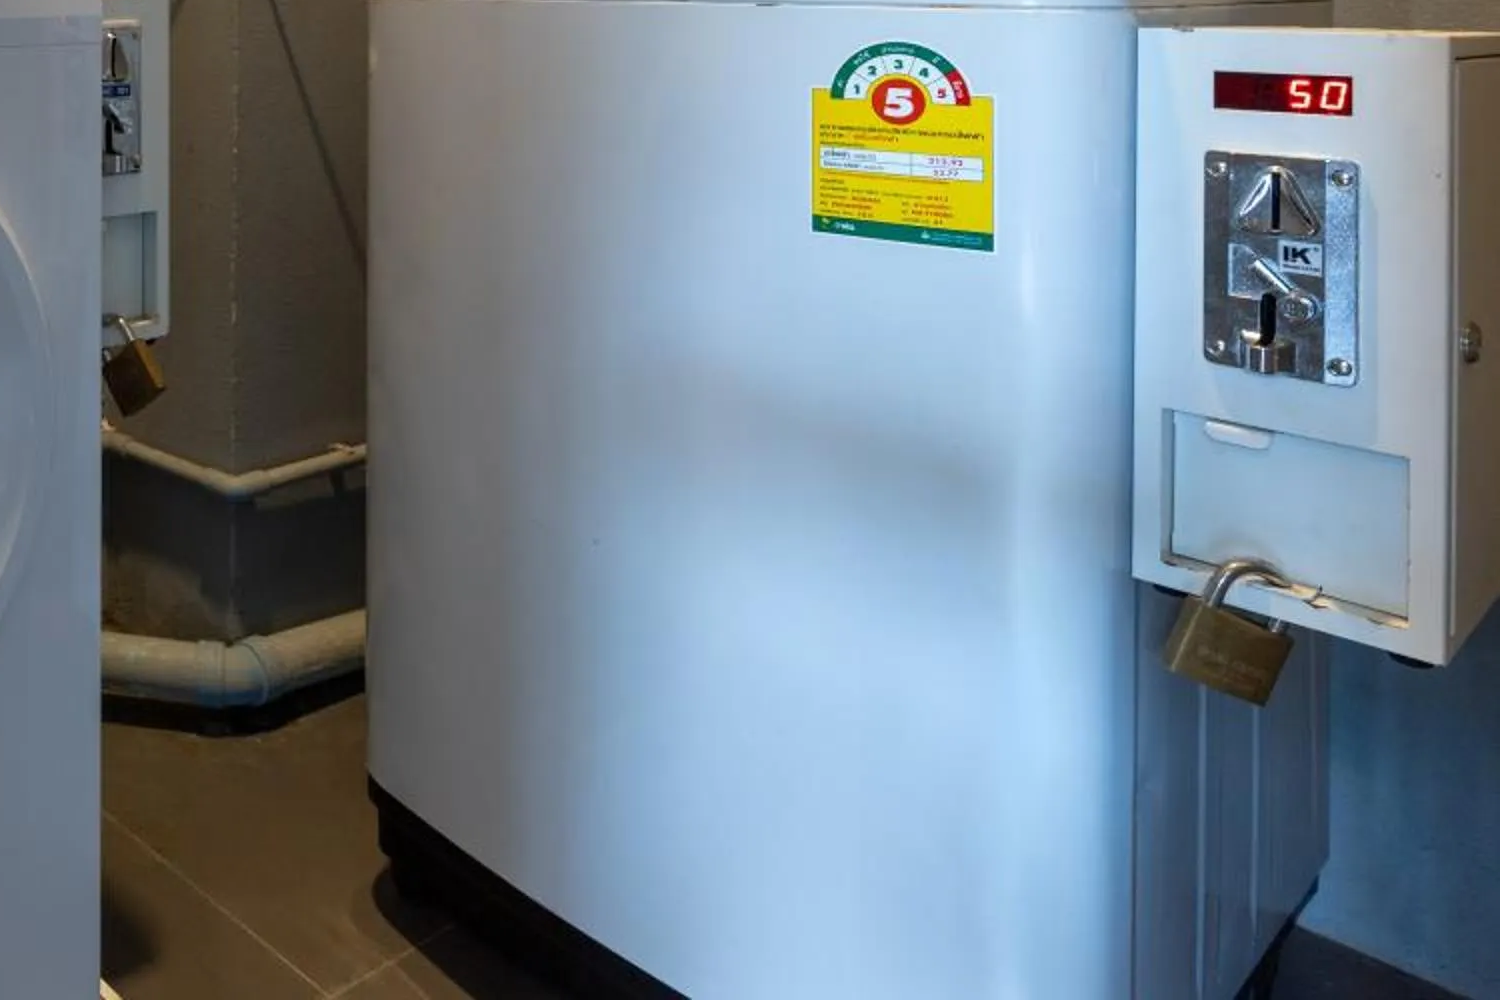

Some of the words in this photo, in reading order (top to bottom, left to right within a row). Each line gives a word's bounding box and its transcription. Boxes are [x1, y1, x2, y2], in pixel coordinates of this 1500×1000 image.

[853, 84, 861, 94] 1
[867, 65, 877, 75] 2
[893, 59, 903, 69] 3
[919, 67, 929, 78] 4
[937, 87, 947, 98] 5
[1288, 78, 1349, 111] 50
[883, 87, 915, 118] 5
